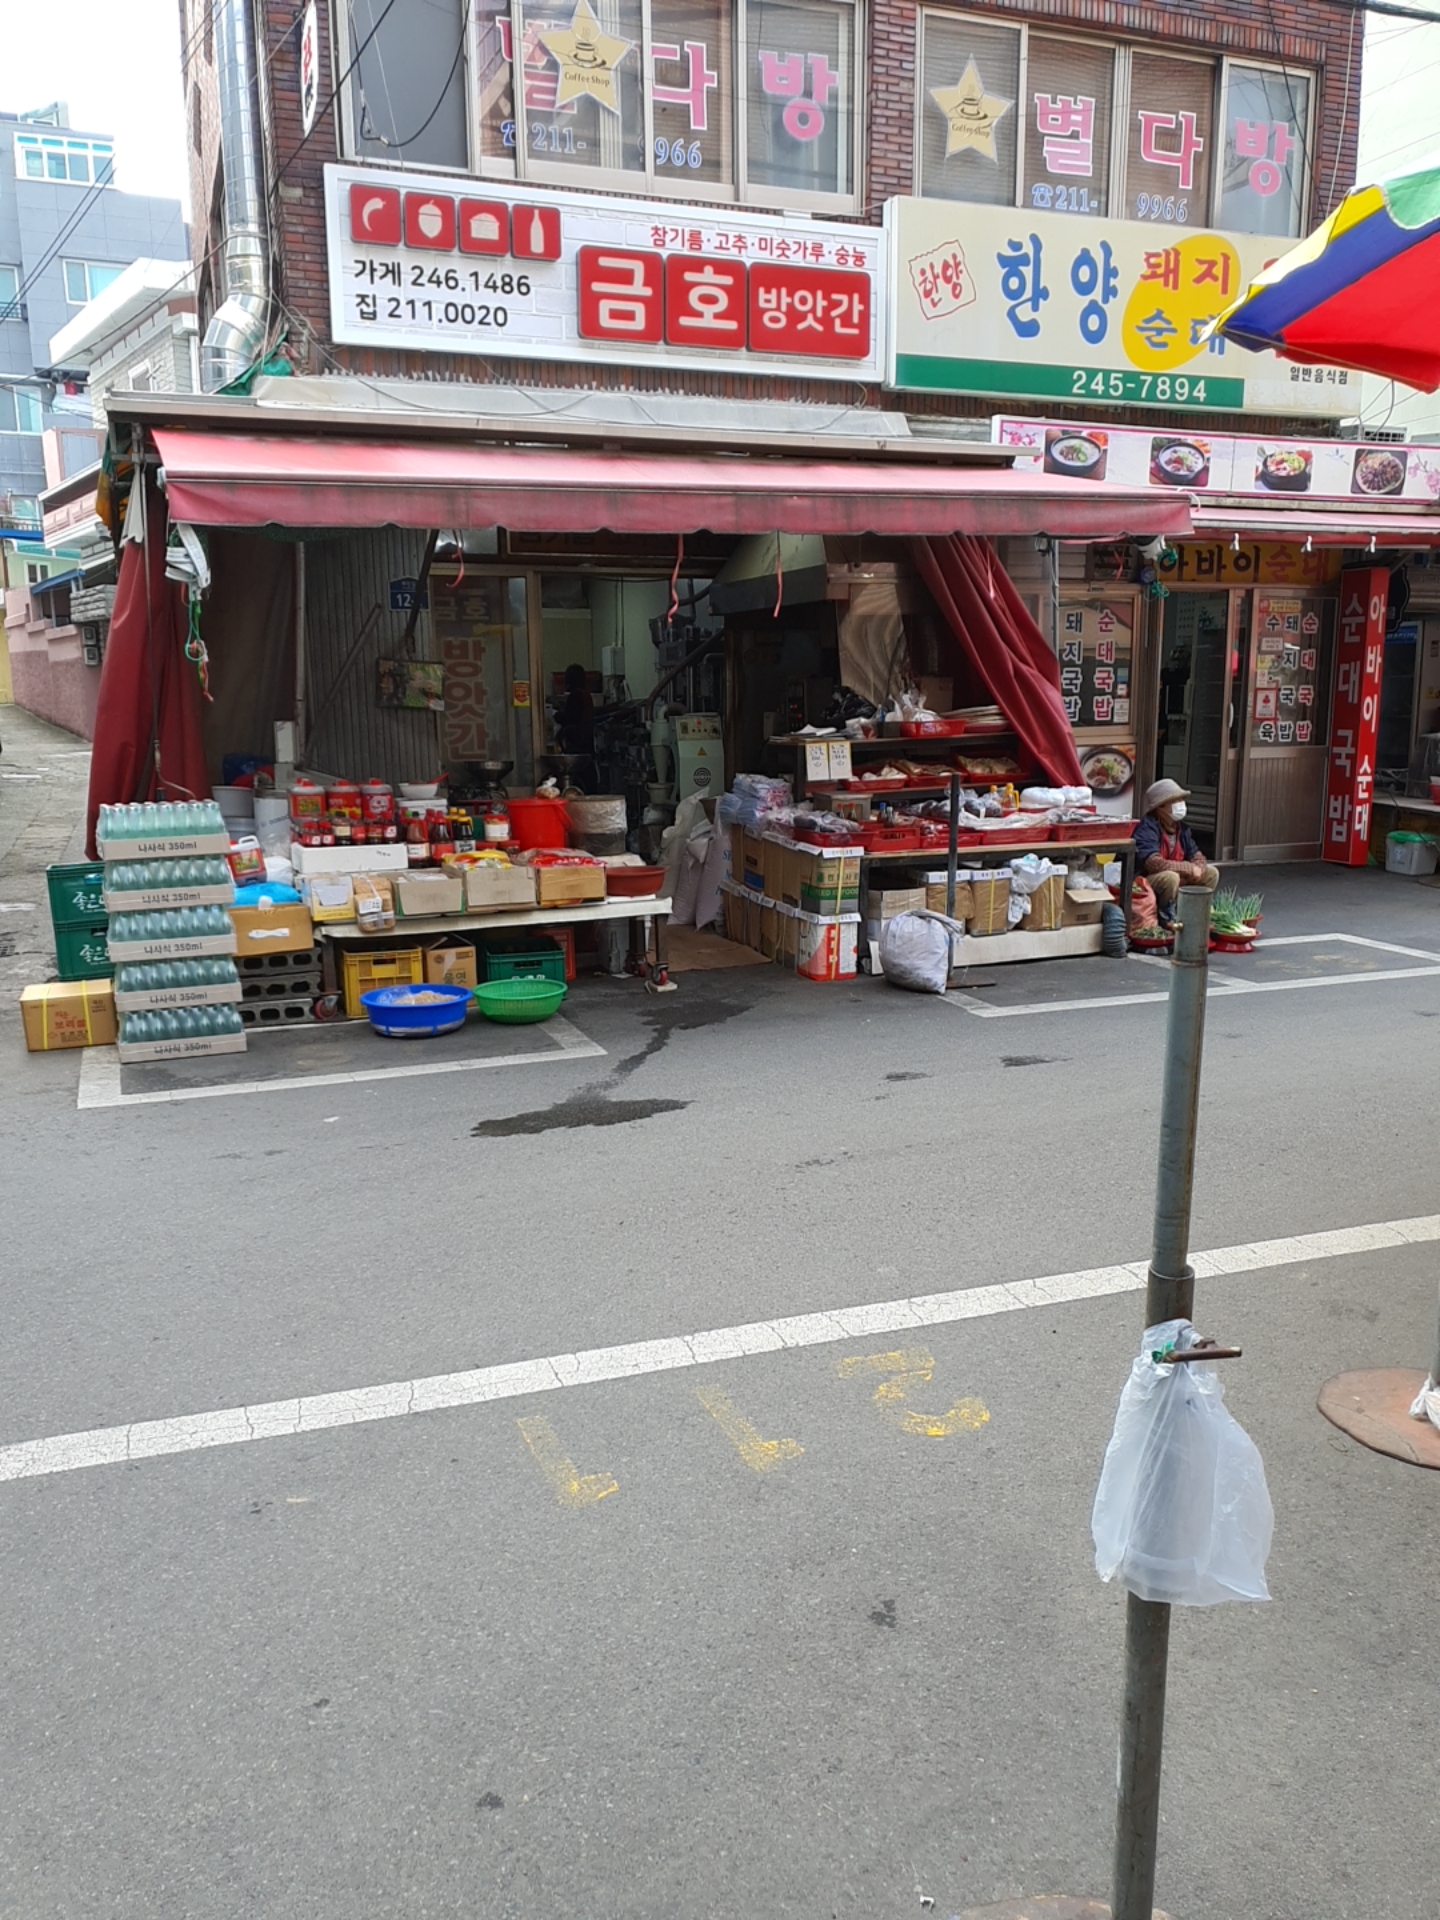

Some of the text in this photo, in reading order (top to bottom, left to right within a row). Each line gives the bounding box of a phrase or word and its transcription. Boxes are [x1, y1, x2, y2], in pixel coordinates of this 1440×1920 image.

[1137, 192, 1188, 223] 9966
[353, 259, 531, 296] 가게 246.1486
[355, 293, 508, 328] 집 211.0020
[591, 256, 864, 336] 금호 방앗간
[918, 253, 964, 308] 한양
[996, 232, 1121, 345] 한양
[1140, 247, 1232, 297] 돼지
[1072, 369, 1207, 403] 245-7894
[1289, 365, 1349, 385] 일반음식점
[442, 636, 489, 762] 방앗간
[1093, 611, 1116, 722] 순대국밥
[1278, 612, 1300, 742] 돼지국밥
[1296, 612, 1319, 742] 순대국밥
[1328, 593, 1366, 843] 순대국밥
[1353, 594, 1385, 841] 아바이 순대
